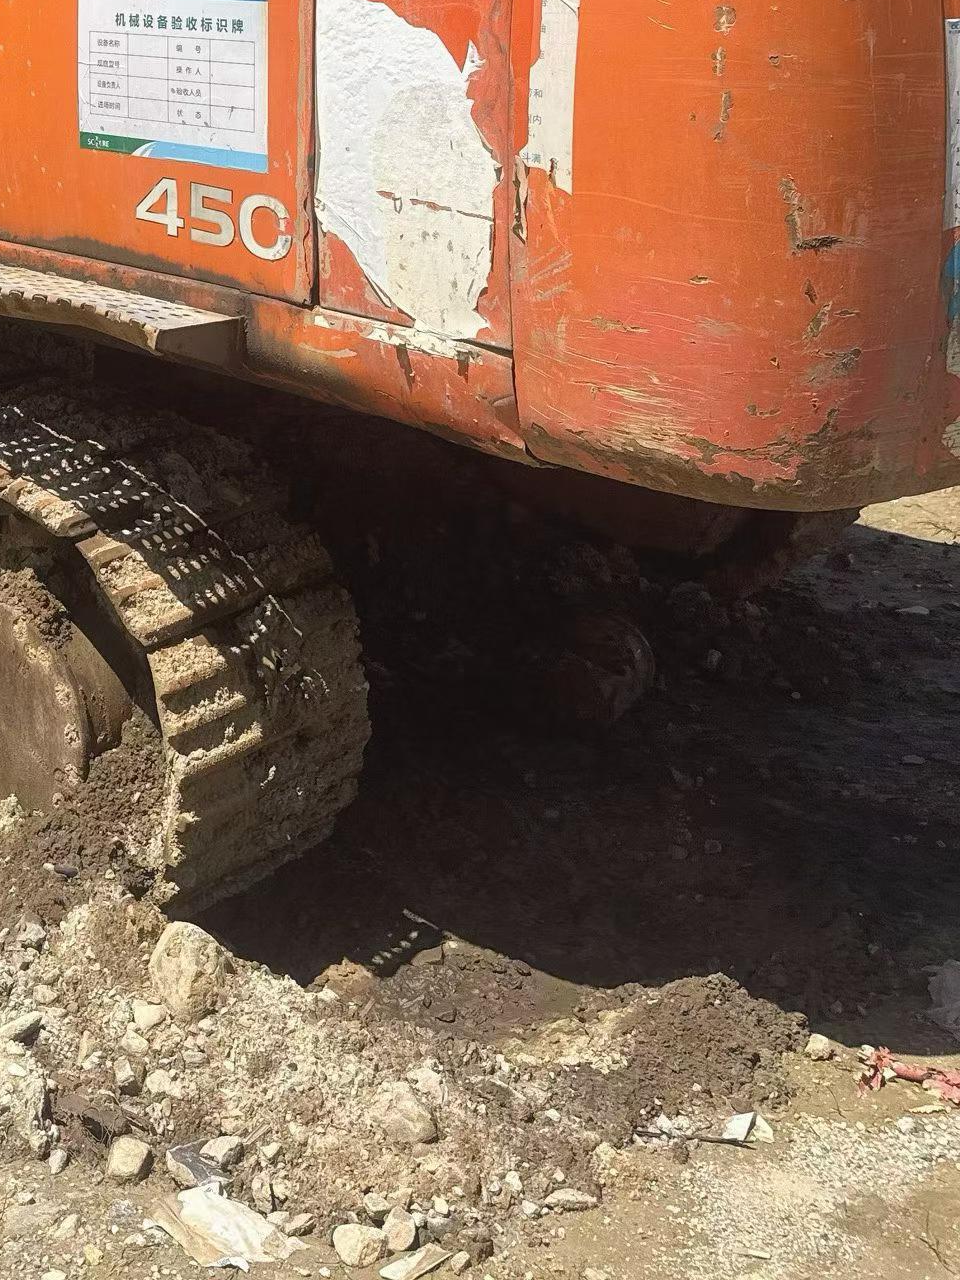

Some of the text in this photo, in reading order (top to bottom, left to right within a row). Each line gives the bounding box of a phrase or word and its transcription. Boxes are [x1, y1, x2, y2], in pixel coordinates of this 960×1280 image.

[115, 12, 244, 34] 机械设备验收标识牌
